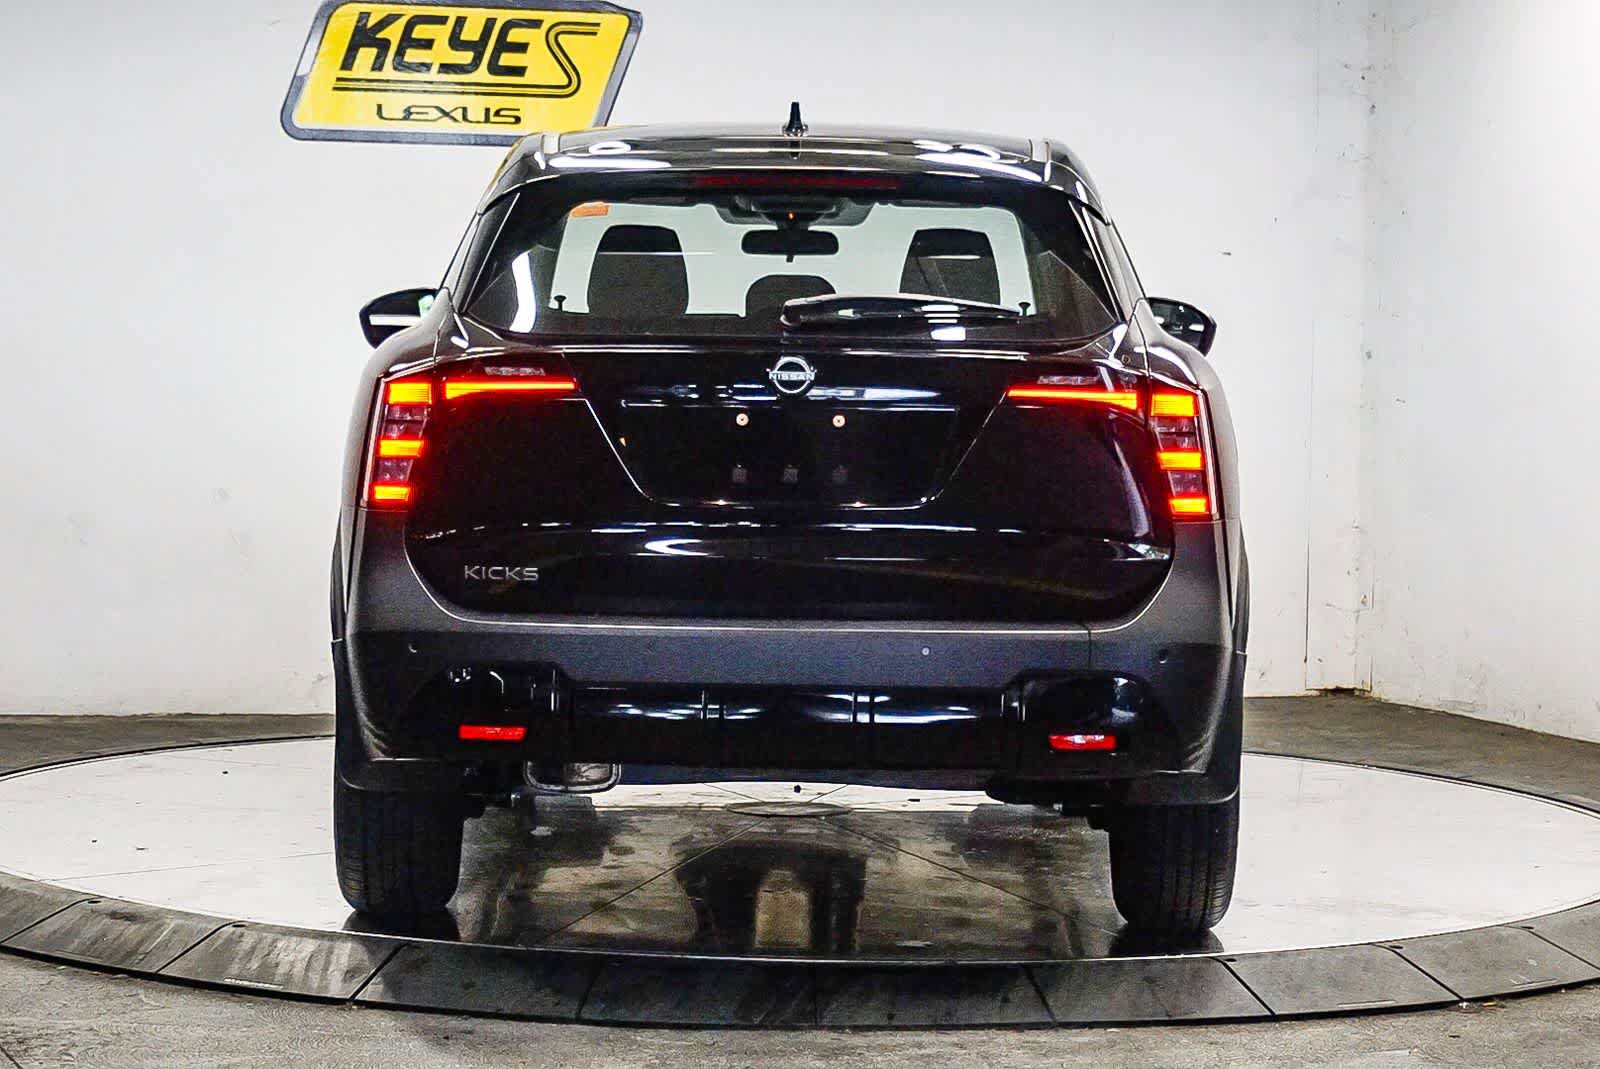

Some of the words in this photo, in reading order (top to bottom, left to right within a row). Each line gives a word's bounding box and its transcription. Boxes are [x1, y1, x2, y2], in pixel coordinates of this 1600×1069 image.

[338, 11, 601, 98] KEYES
[376, 103, 522, 125] LEXUS
[768, 371, 816, 381] NISSAN
[464, 565, 539, 581] KICKS
